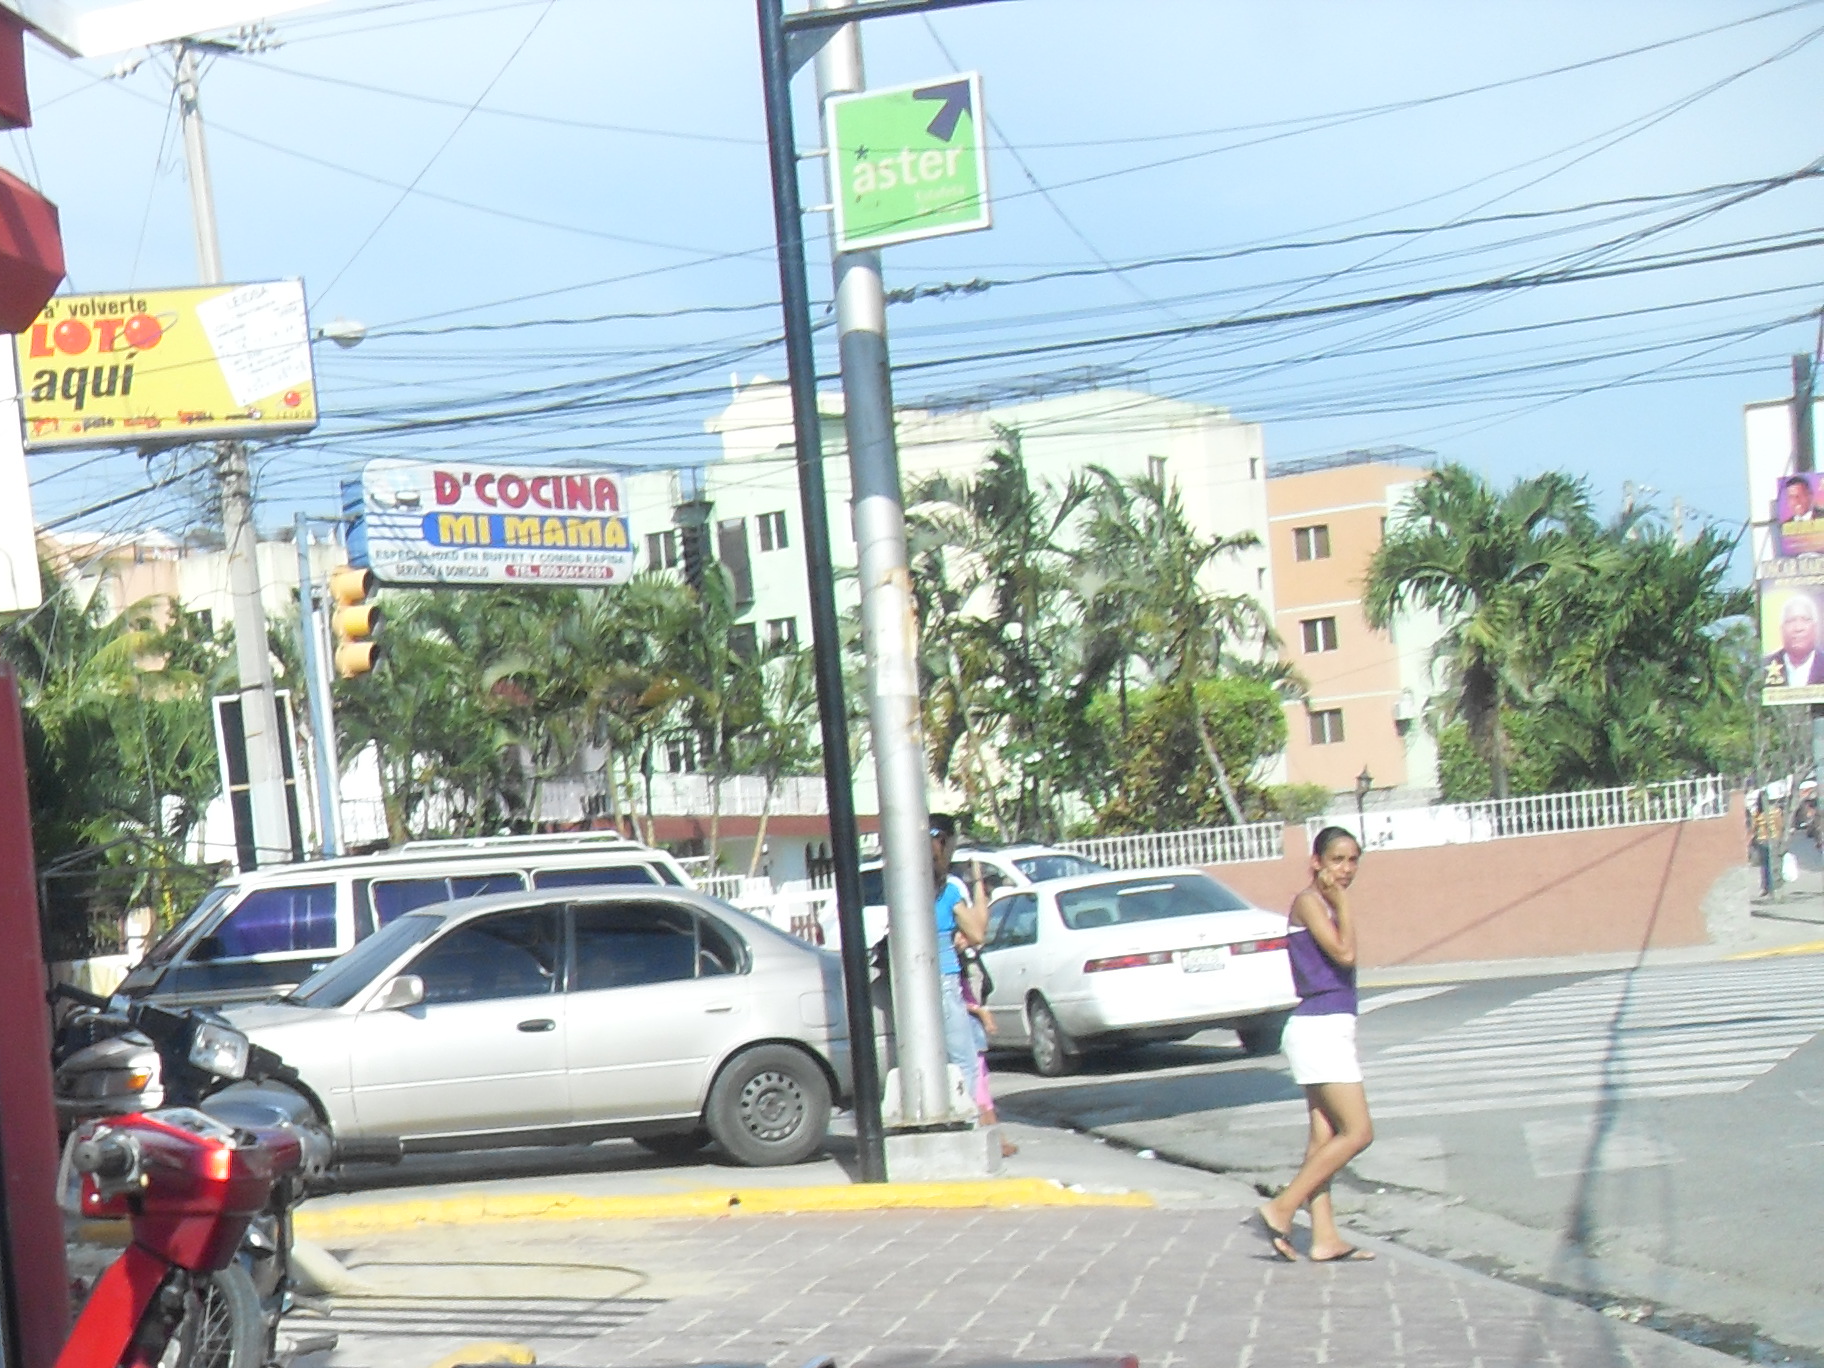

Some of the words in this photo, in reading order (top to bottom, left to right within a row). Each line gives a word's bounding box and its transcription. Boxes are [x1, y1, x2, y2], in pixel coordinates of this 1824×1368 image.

[852, 146, 962, 196] aster
[69, 296, 148, 318] volverte
[29, 313, 164, 359] LOTO
[31, 352, 139, 412] aquí
[433, 471, 619, 511] D'COCINA
[438, 514, 492, 546] MI
[503, 514, 628, 549] MAMÁ
